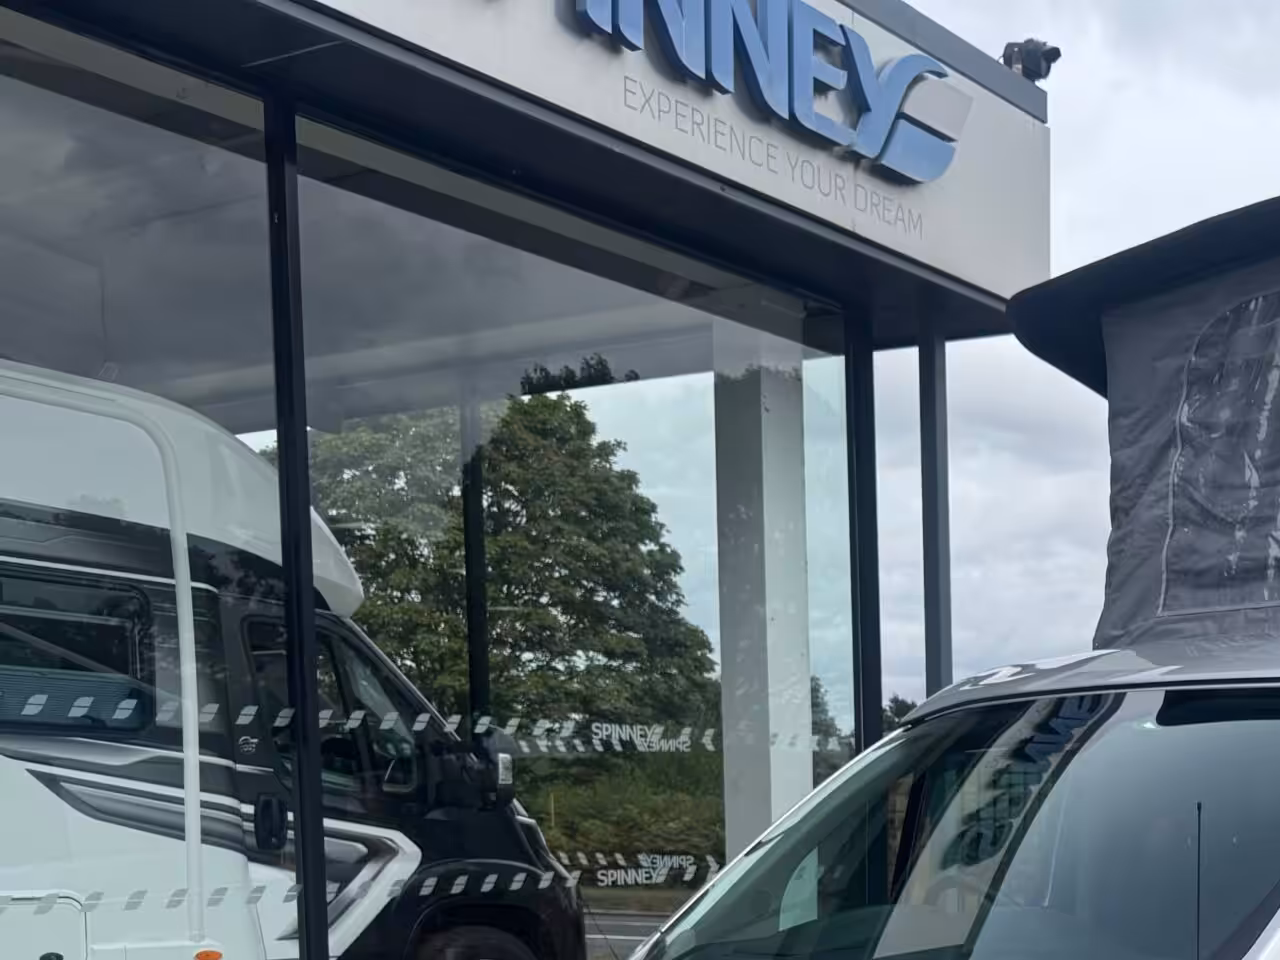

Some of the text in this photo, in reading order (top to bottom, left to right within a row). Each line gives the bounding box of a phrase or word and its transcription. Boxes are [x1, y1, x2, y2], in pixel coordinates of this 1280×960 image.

[622, 74, 924, 240] EXPERIENCE YOUR DREAM
[591, 721, 657, 741] SPINNEY
[596, 868, 658, 887] SPINNEY
